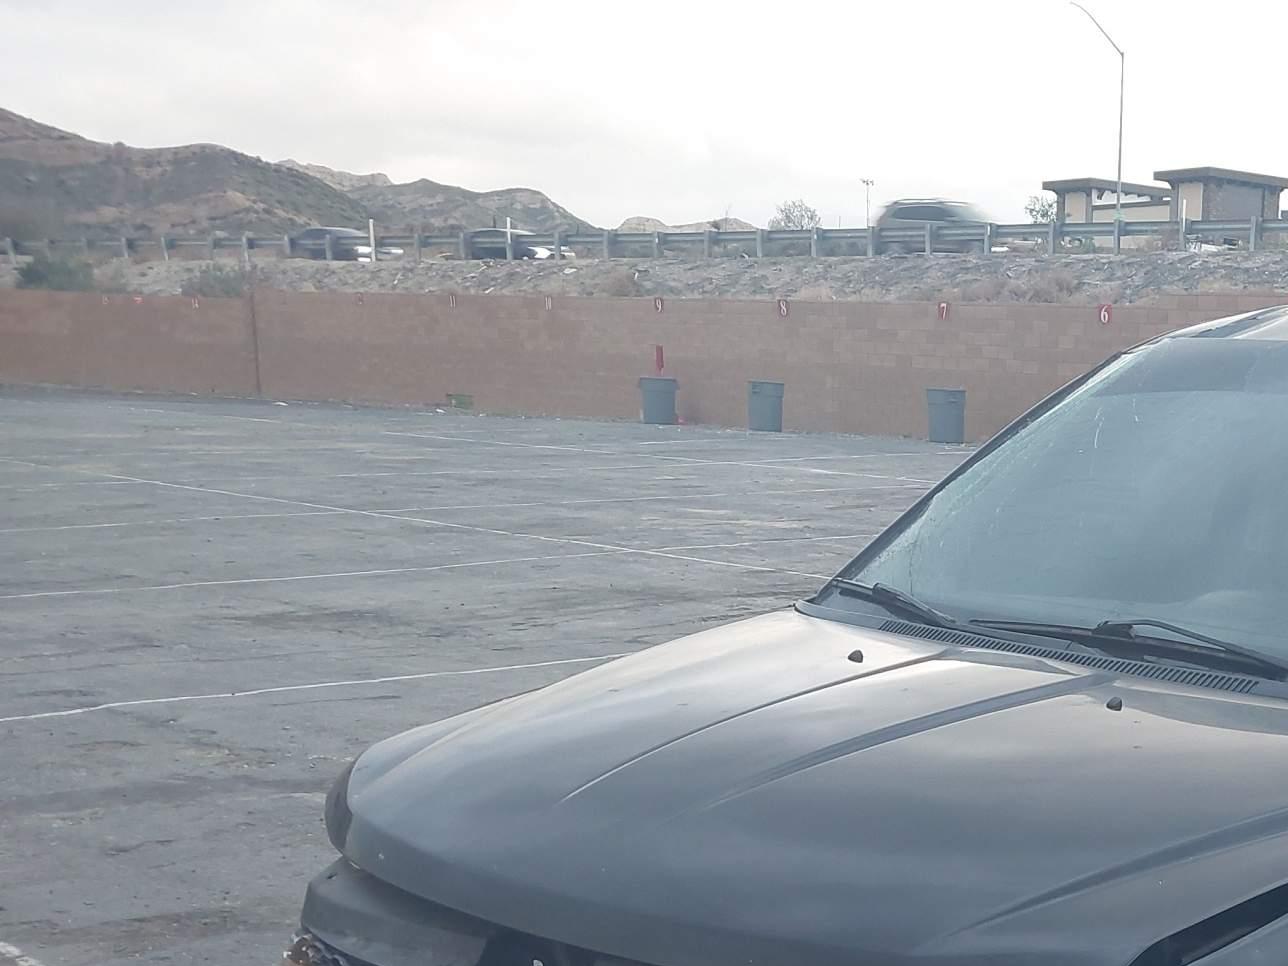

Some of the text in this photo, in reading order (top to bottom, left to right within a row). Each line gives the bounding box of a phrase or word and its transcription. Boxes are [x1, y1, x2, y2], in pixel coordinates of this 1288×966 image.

[779, 300, 788, 316] 8
[939, 302, 948, 319] 7
[1100, 304, 1109, 324] 6
